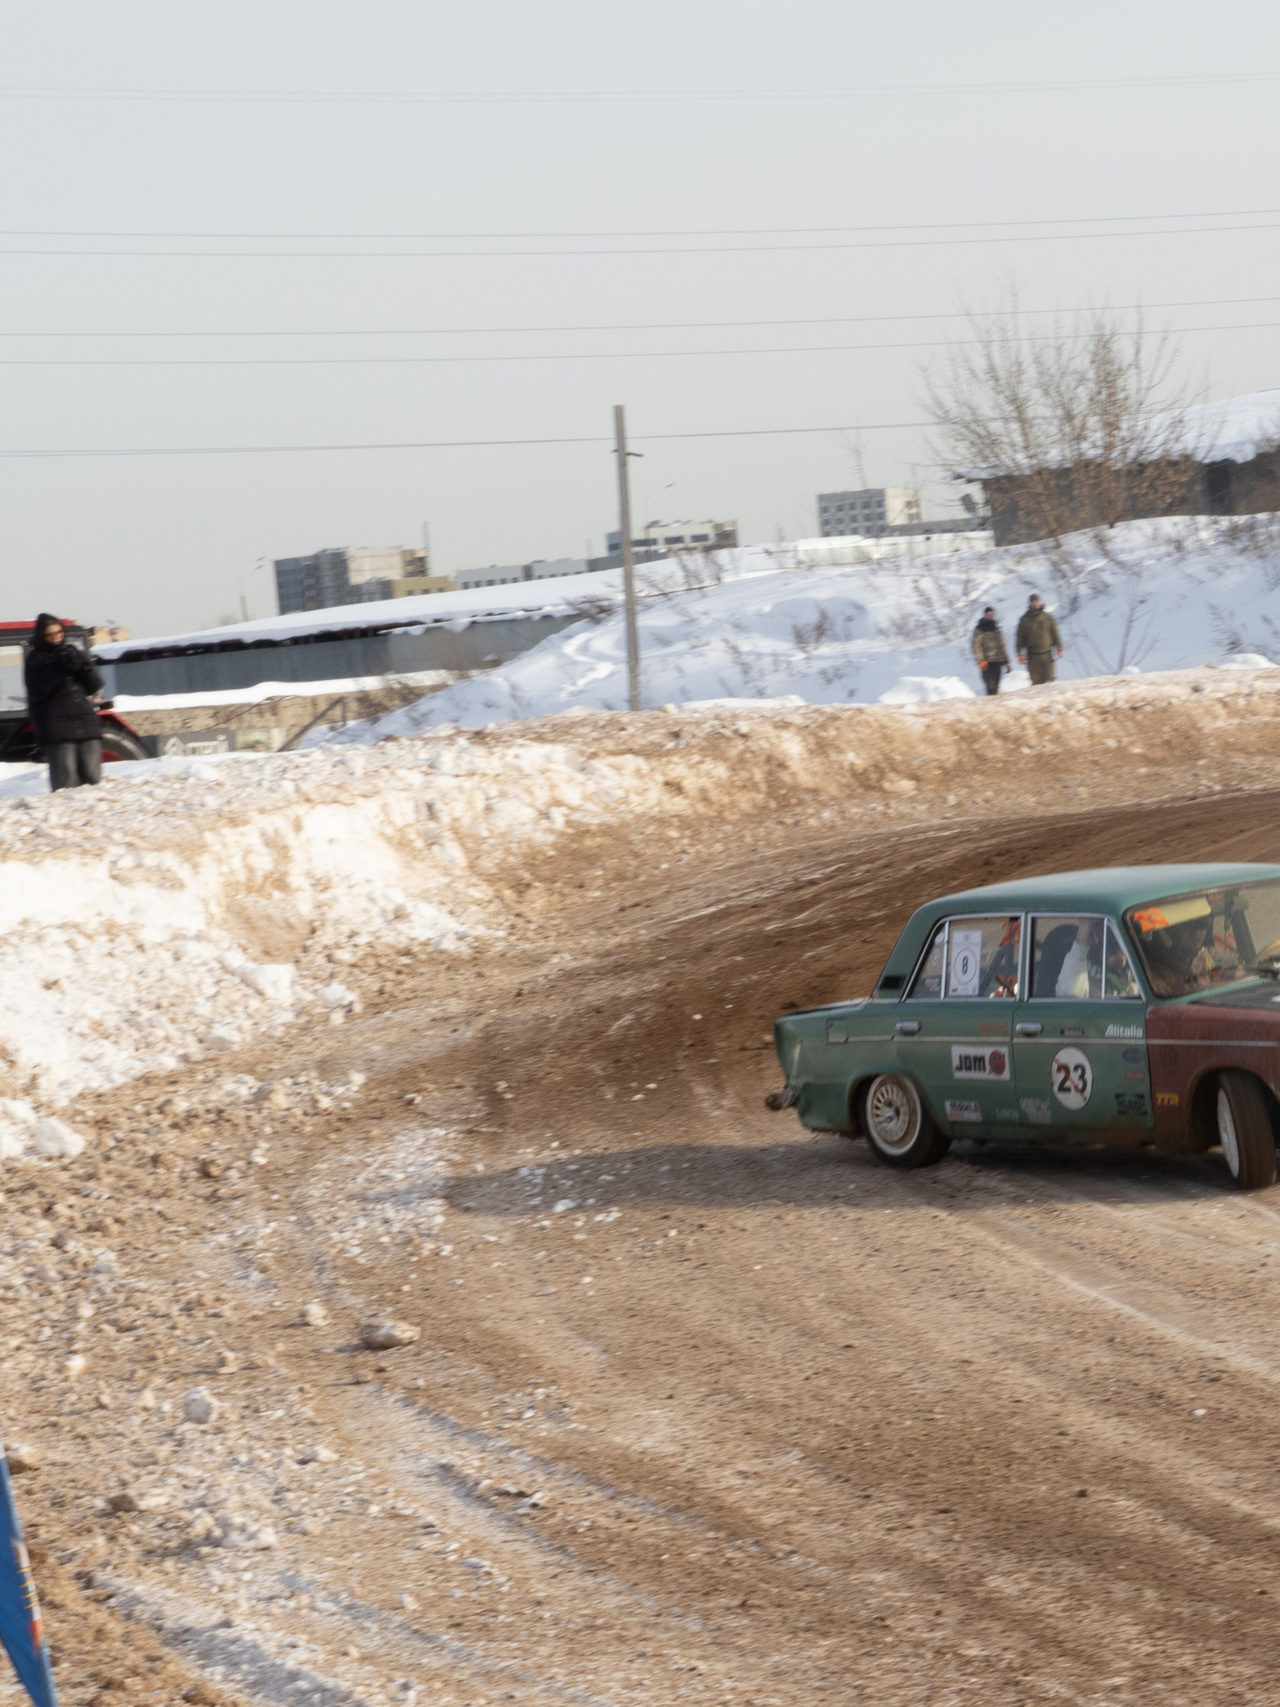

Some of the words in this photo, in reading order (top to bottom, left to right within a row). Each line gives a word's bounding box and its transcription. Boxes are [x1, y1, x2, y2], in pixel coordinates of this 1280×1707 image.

[961, 955, 969, 975] 8
[1104, 1024, 1143, 1039] Alitalia
[1056, 1064, 1088, 1093] 23
